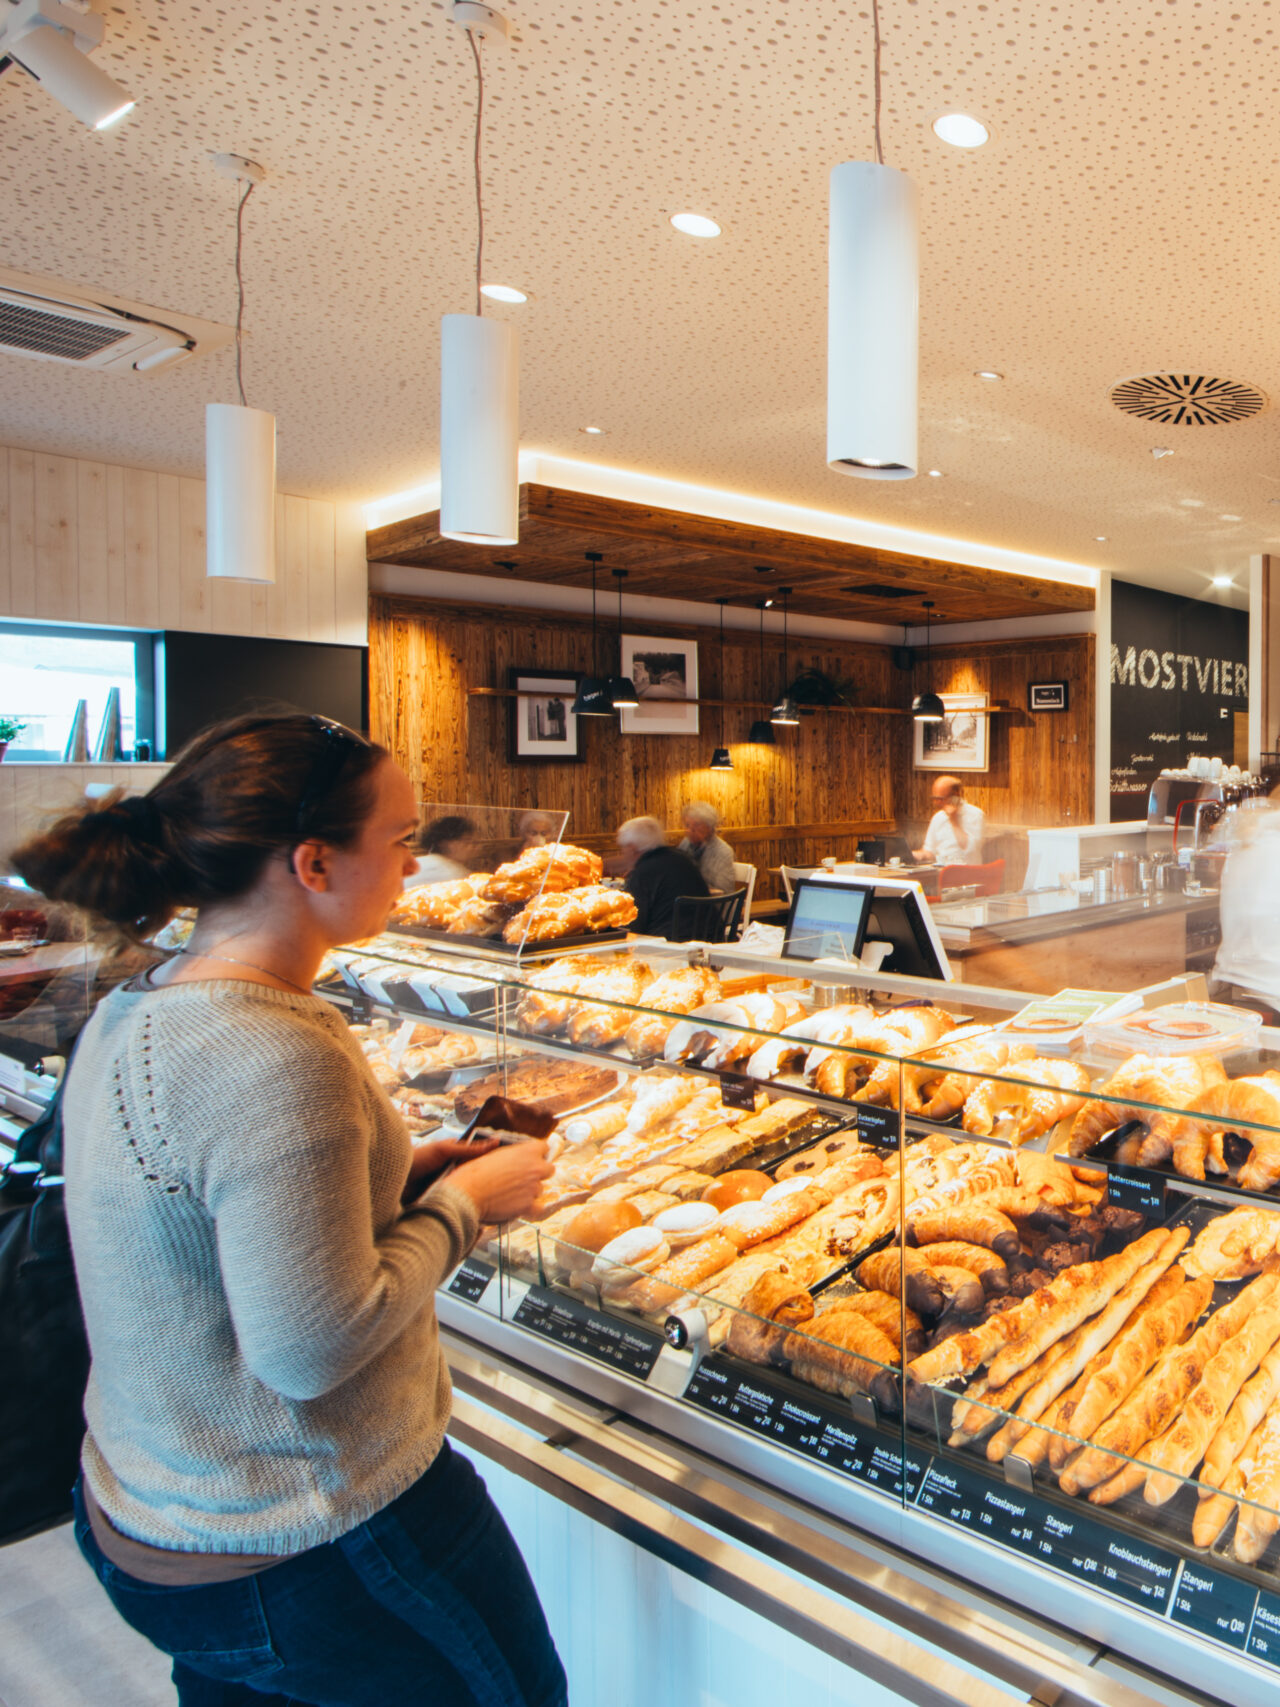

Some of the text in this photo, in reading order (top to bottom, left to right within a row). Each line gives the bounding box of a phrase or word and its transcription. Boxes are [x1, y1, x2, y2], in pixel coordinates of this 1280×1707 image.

[1110, 643, 1249, 697] MOSTVIER
[984, 1491, 1026, 1517] Pizzastangerl
[1045, 1514, 1074, 1535] Stangerl
[1072, 1557, 1083, 1568] nur
[1108, 1542, 1172, 1578] Knoblauchstangerl
[1140, 1584, 1153, 1596] nur
[1182, 1571, 1214, 1593] Stangerl
[1180, 1599, 1192, 1612] Stk
[1216, 1617, 1230, 1629] nur
[1256, 1638, 1269, 1652] Stk
